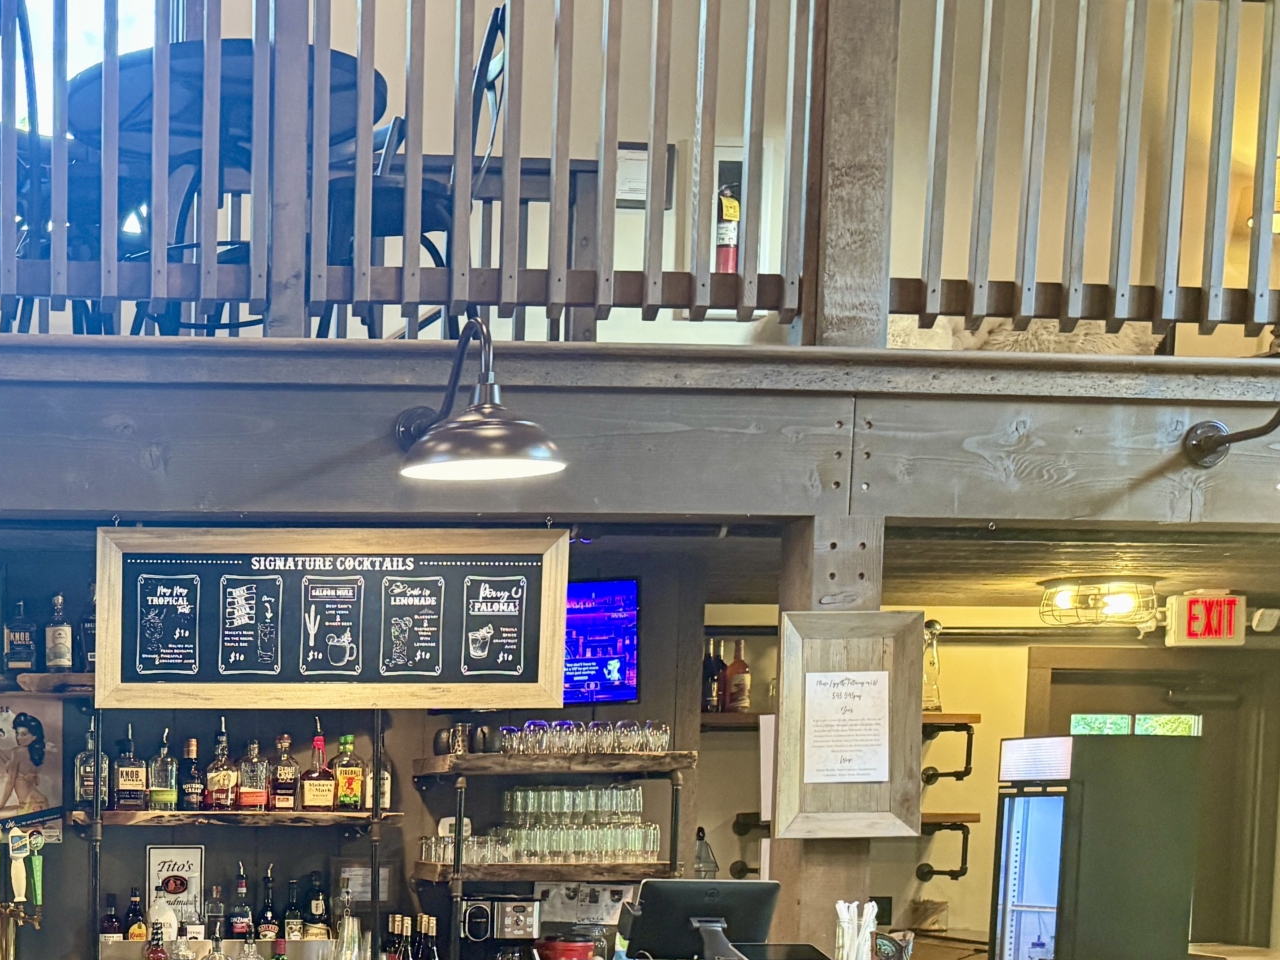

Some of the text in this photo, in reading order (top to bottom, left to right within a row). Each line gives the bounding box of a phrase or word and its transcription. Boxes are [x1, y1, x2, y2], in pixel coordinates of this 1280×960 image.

[251, 557, 414, 570] SIGNATURE COCKTAILS
[311, 588, 354, 597] SALOON MULE
[147, 597, 189, 605] TROPICAL
[391, 597, 437, 606] LEMONADE
[474, 602, 516, 612] PALOMA
[1186, 597, 1239, 638] EXIT
[10, 632, 30, 641] KNOB
[174, 628, 189, 639] $10
[229, 651, 245, 663] $10
[307, 651, 323, 662] $10
[415, 651, 431, 662] $10
[497, 652, 513, 663] $10
[120, 770, 140, 779] KNOB
[339, 769, 361, 777] FIREBALL
[157, 860, 193, 872] Tito's
